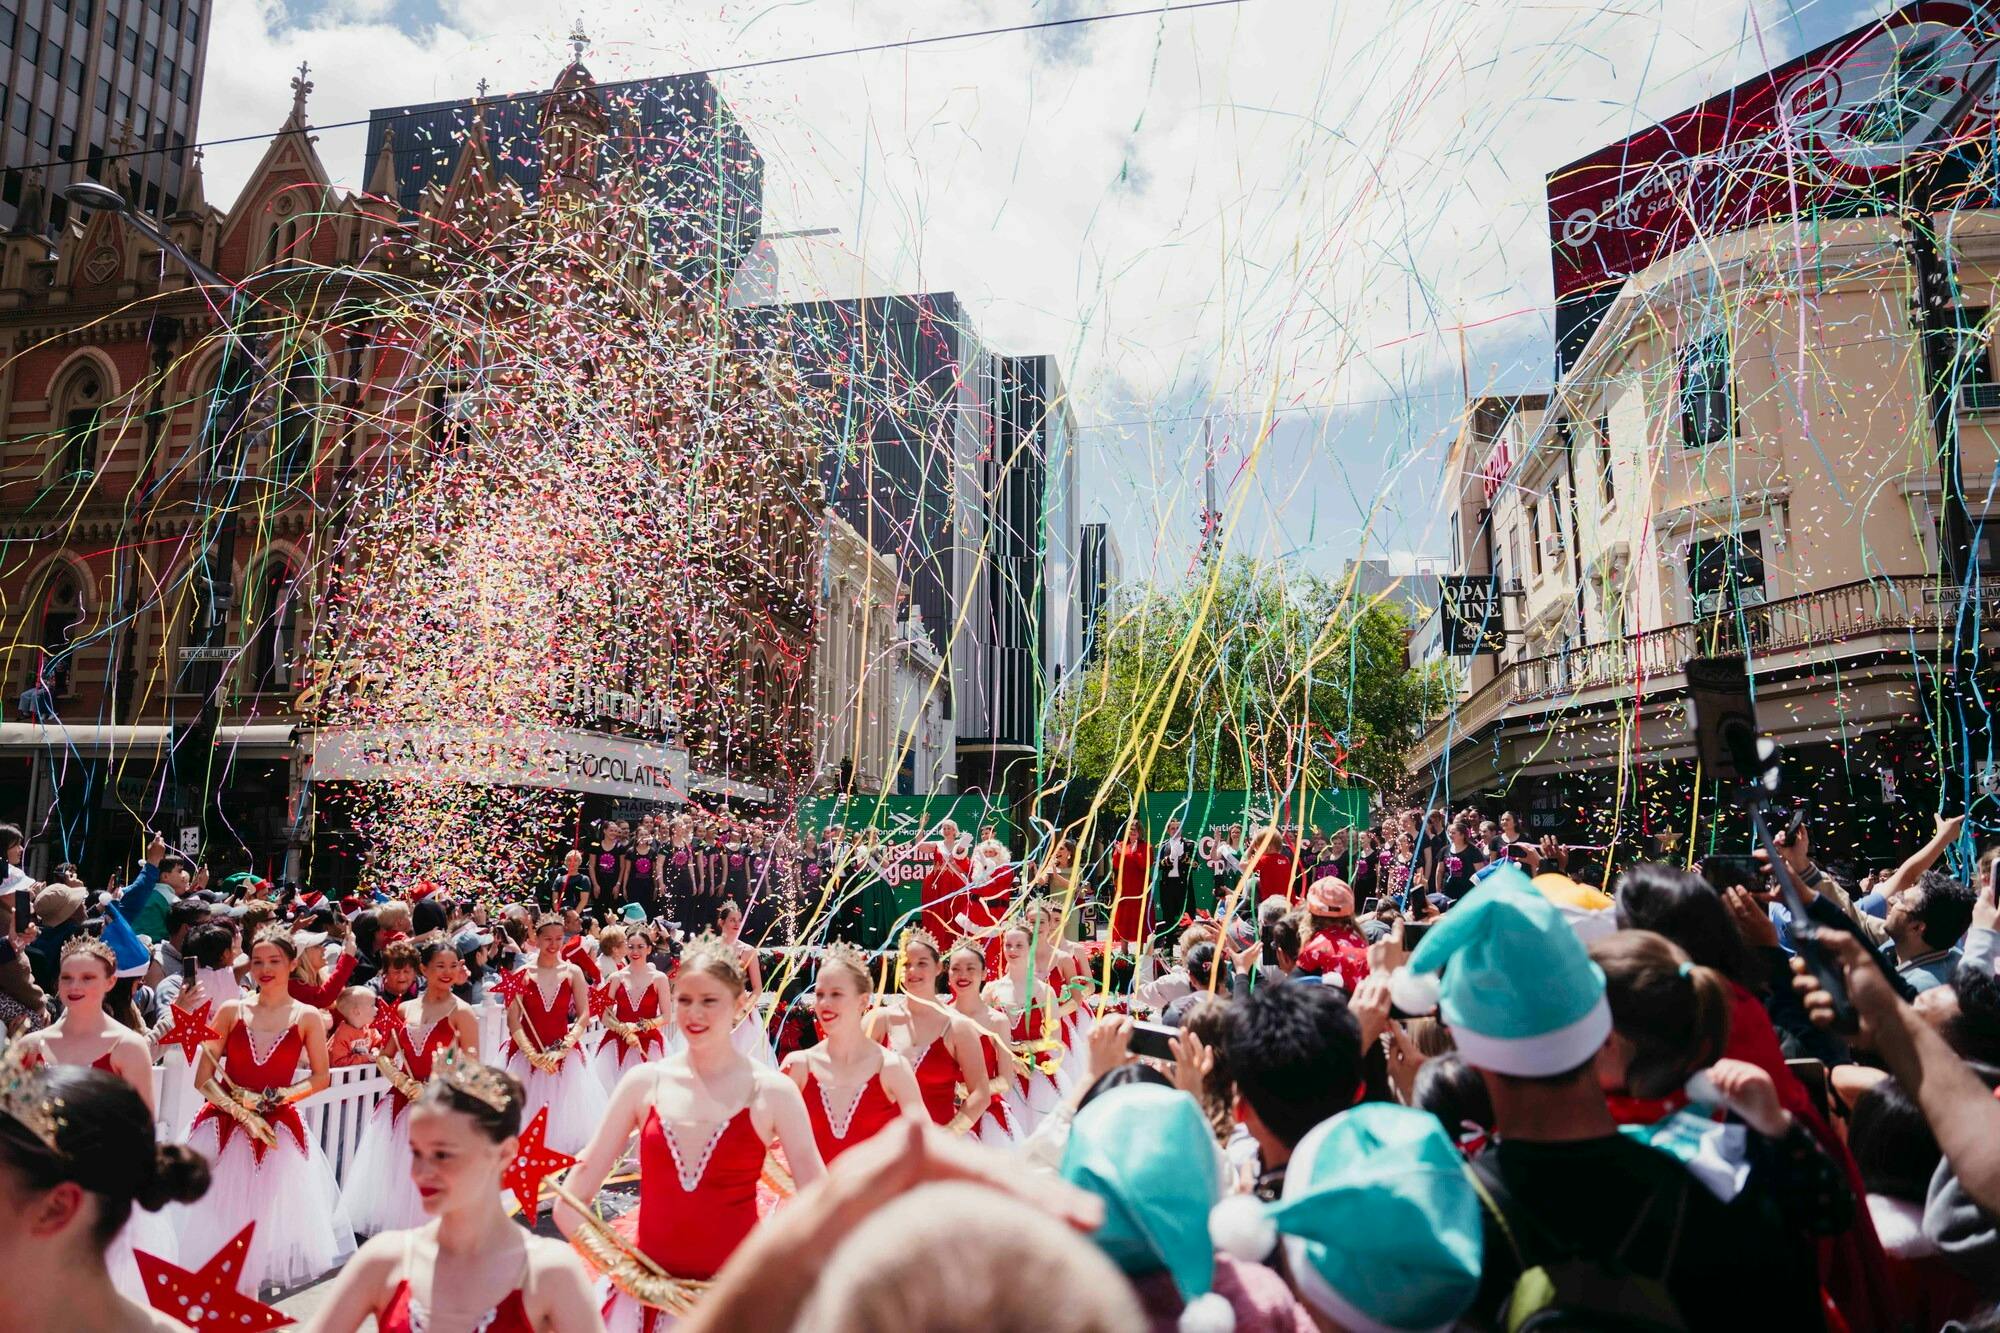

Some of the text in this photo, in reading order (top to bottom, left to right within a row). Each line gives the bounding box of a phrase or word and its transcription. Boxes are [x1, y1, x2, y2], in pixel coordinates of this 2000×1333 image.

[1604, 204, 1641, 232] TOY
[1445, 584, 1499, 601] OPAL
[1939, 588, 1961, 602] KING
[1446, 601, 1502, 619] MINE
[187, 649, 203, 659] KING
[204, 649, 228, 658] WILLIAM
[543, 748, 672, 789] CHOCOLATES
